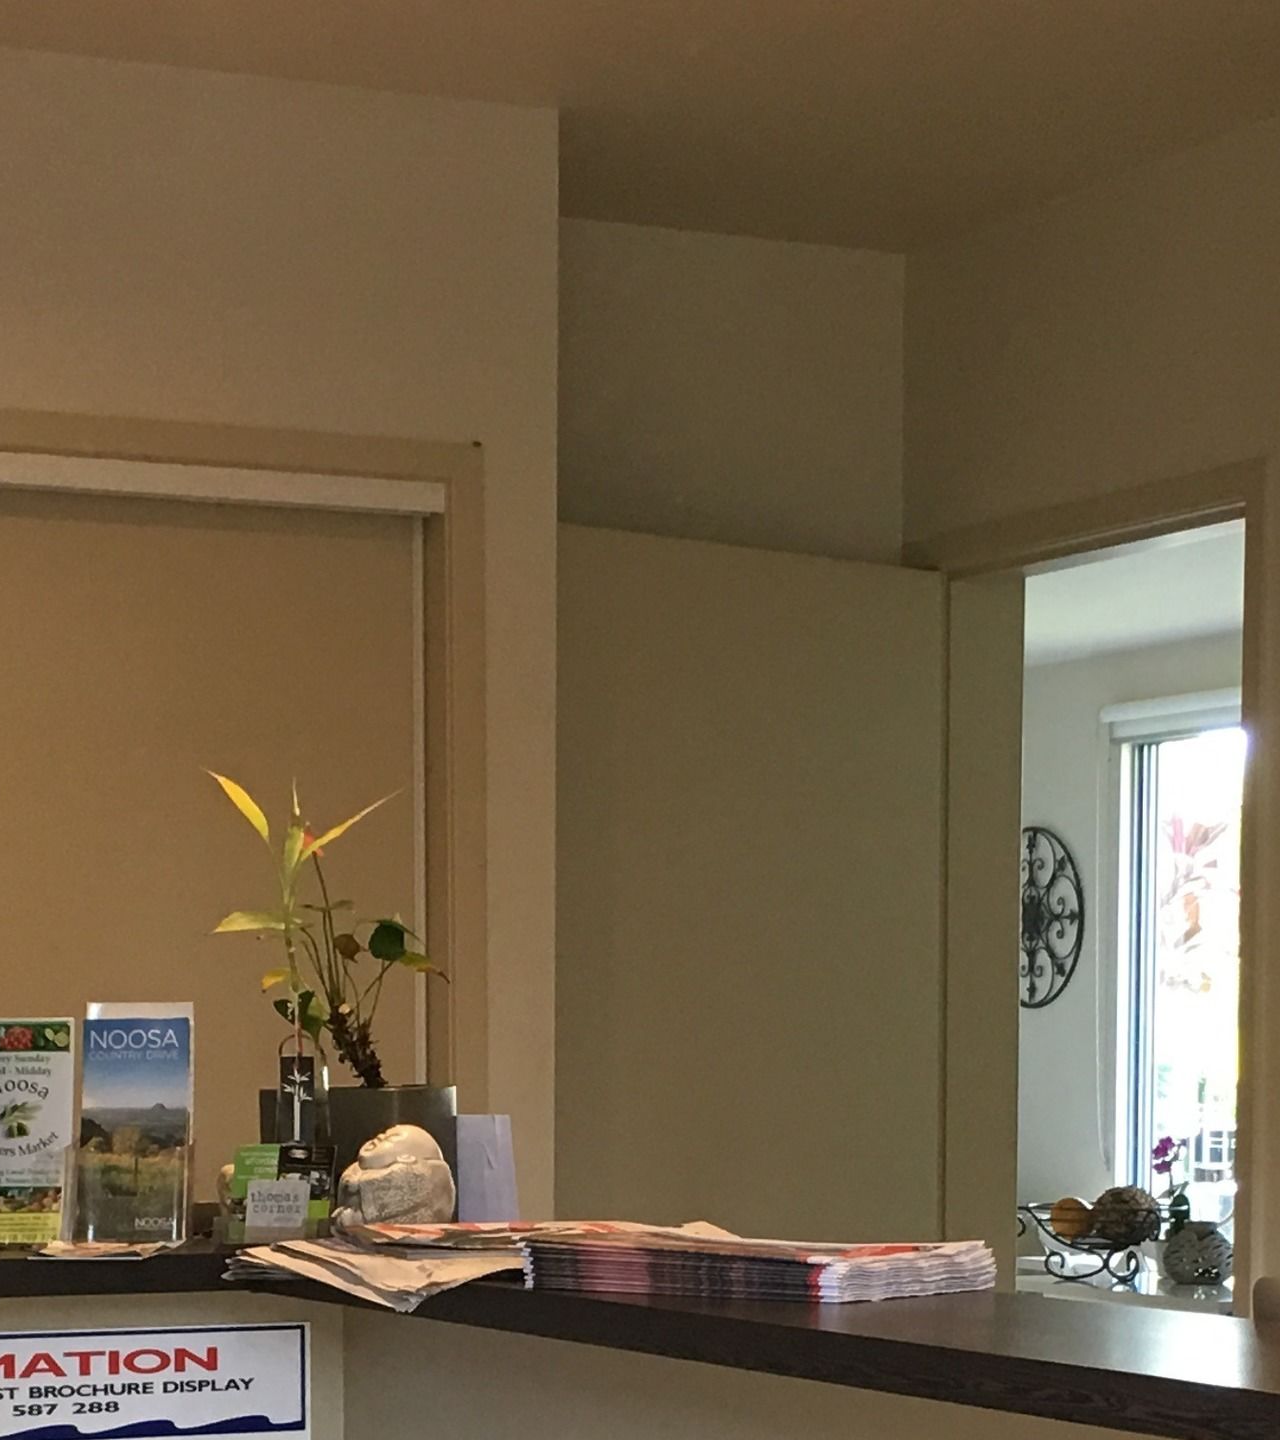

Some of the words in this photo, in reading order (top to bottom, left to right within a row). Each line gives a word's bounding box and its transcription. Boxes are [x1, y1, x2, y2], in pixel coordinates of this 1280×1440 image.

[89, 1028, 179, 1050] NOOSA
[14, 1053, 51, 1064] Sunday
[14, 1066, 52, 1077] Midday
[18, 1129, 60, 1157] Market
[250, 1190, 300, 1203] thomas
[252, 1204, 301, 1214] corner
[29, 1382, 154, 1400] BROCHURE
[161, 1377, 255, 1394] DISPLAY
[12, 1402, 57, 1417] 587
[72, 1401, 120, 1415] 288
